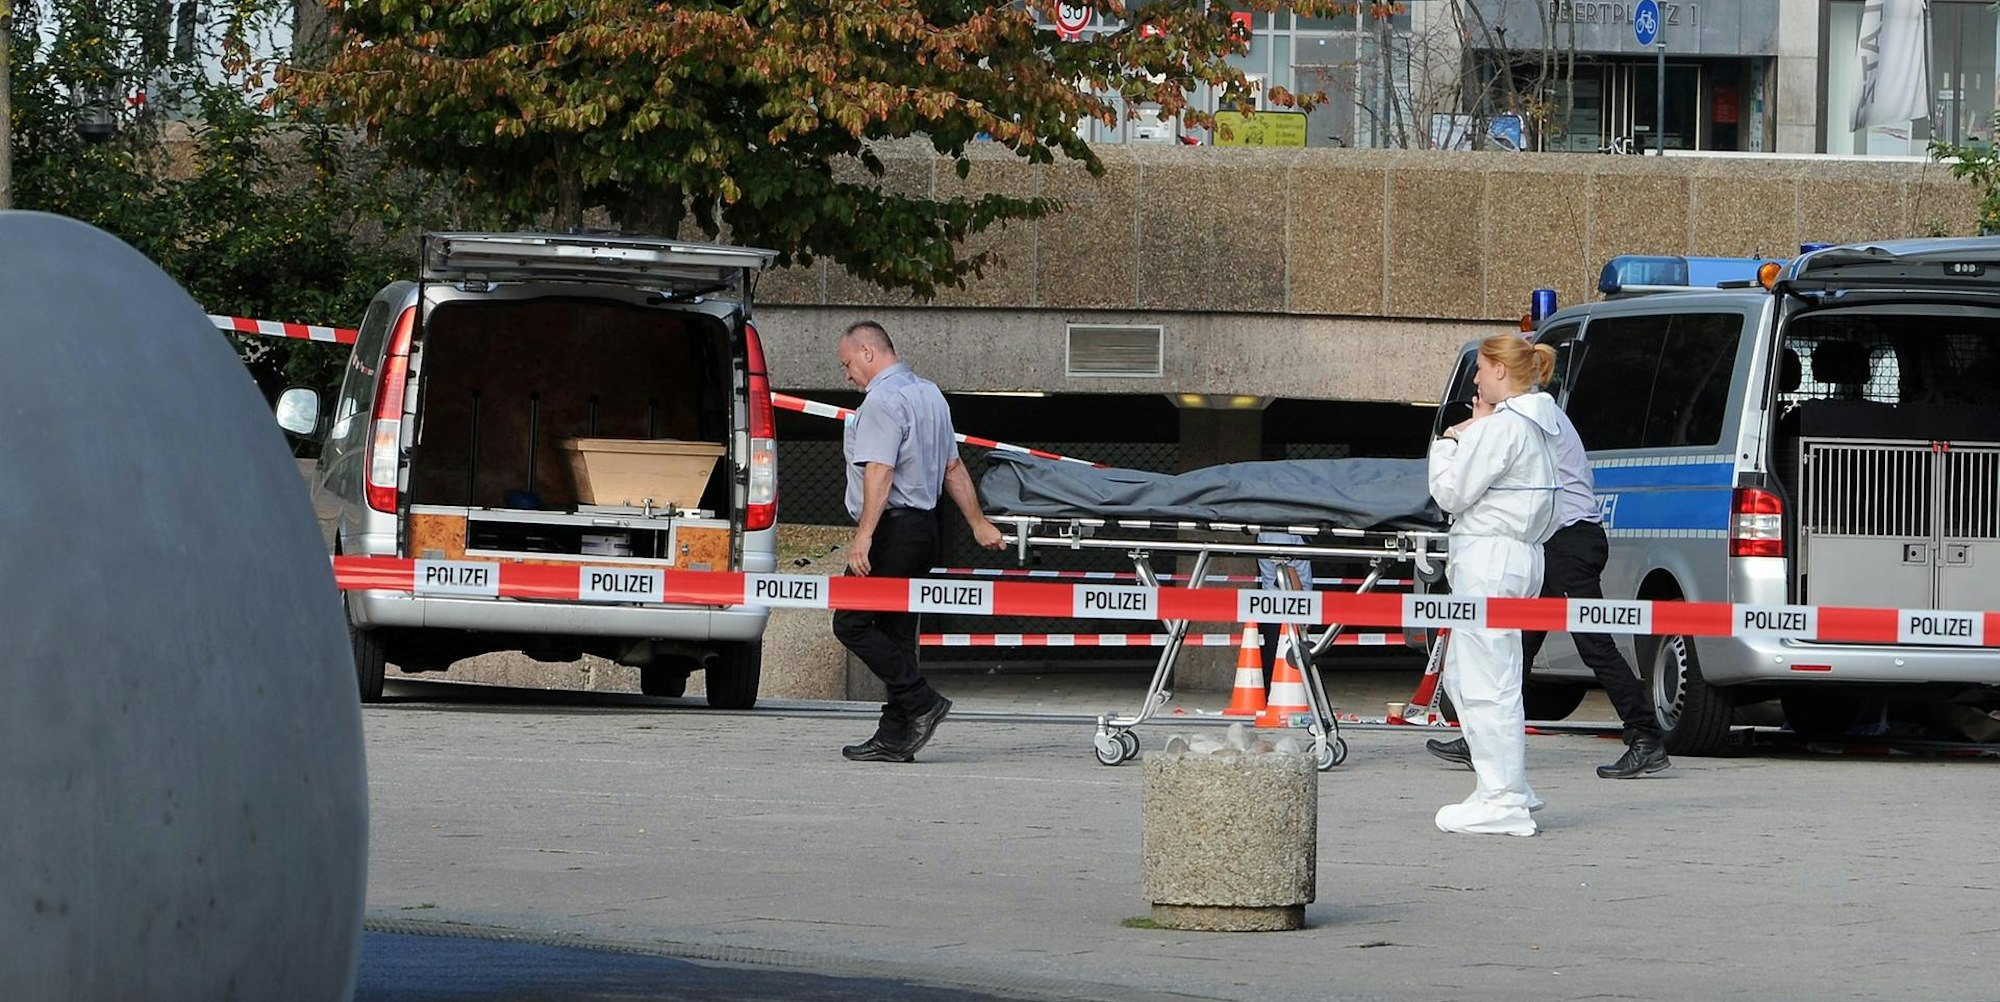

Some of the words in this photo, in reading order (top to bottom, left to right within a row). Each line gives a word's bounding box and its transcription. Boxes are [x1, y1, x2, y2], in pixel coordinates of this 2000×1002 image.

[1062, 3, 1083, 20] 30
[1548, 1, 1680, 26] EBERTPLZ
[426, 566, 488, 586] POLIZEI
[591, 572, 653, 594] POLIZEI
[756, 579, 818, 600] POLIZEI
[920, 585, 982, 606] POLIZEI
[1085, 591, 1147, 611] POLIZEI
[1249, 596, 1311, 616] POLIZEI
[1414, 601, 1476, 621] POLIZEI
[1579, 605, 1641, 626] POLIZEI
[1744, 611, 1807, 631] POLIZEI
[1910, 616, 1973, 637] POLIZEI
